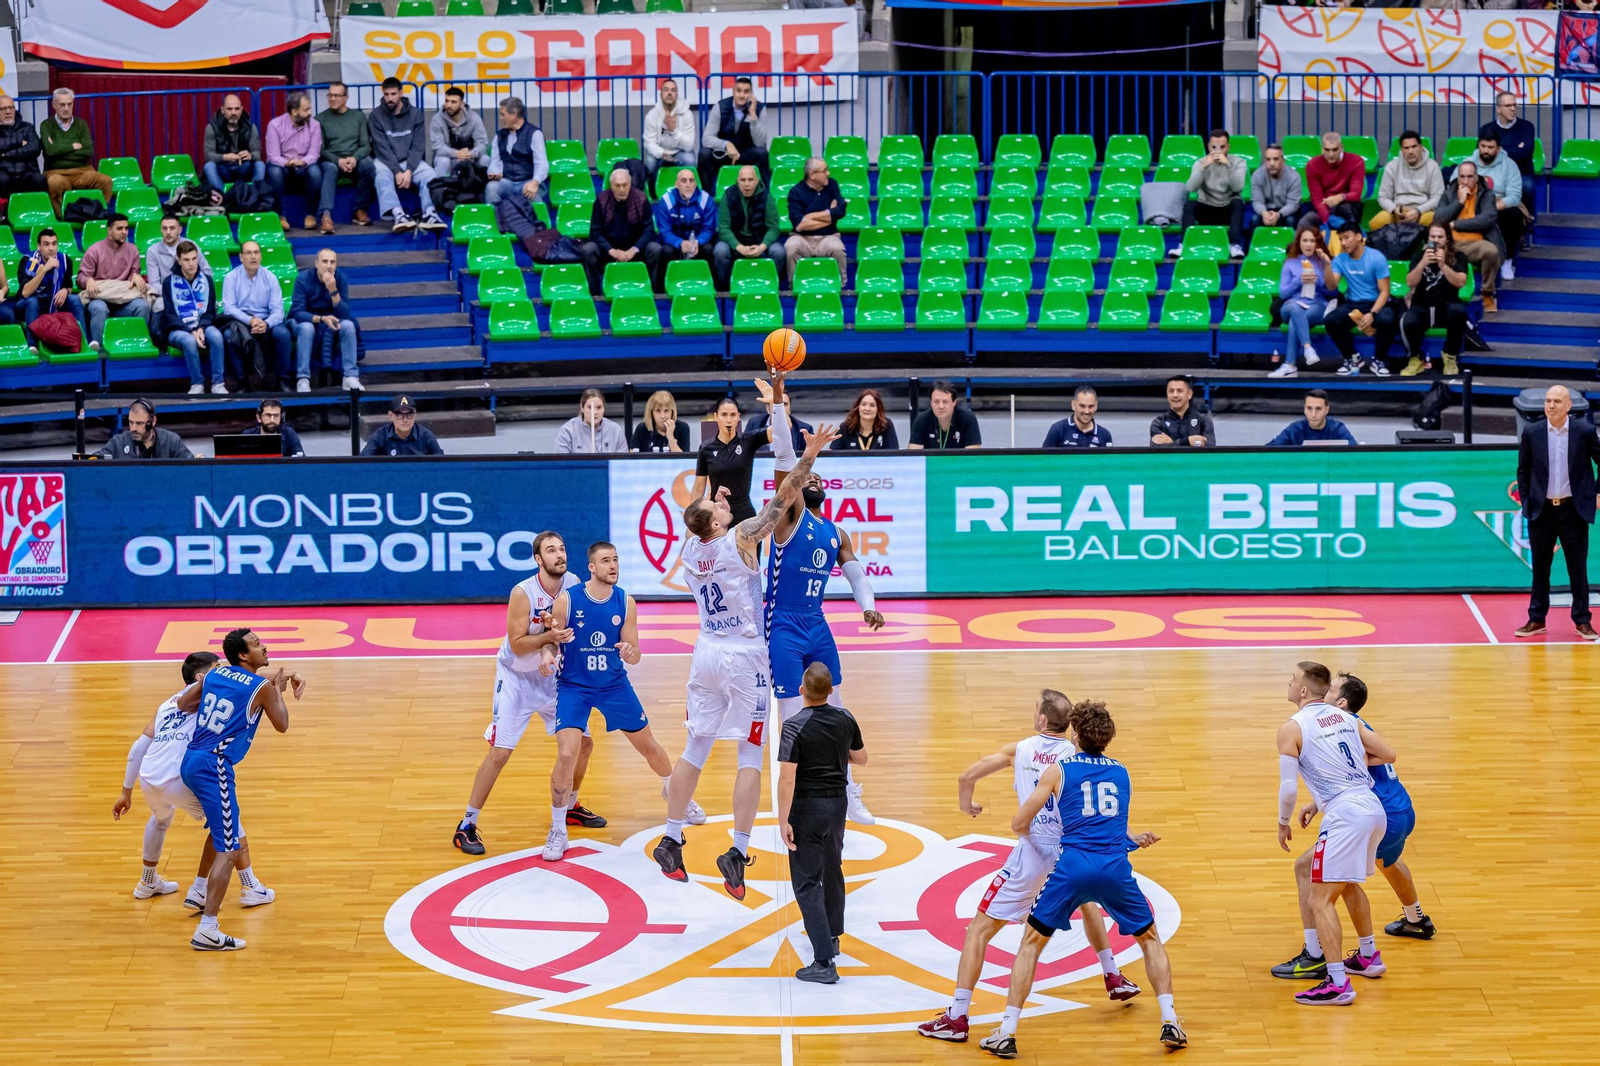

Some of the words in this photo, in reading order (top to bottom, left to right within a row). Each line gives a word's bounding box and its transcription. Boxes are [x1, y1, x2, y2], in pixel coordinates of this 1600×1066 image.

[364, 30, 516, 59] SOLO
[518, 22, 847, 93] GANAR
[369, 62, 511, 94] VALE
[195, 491, 474, 529] MONBUS
[955, 484, 1177, 532] REAL
[1208, 481, 1457, 529] BETIS
[124, 530, 539, 576] OBRADOIRO
[1044, 533, 1367, 560] BALONCESTO
[15, 566, 62, 575] OBRADOIRO
[700, 582, 728, 616] 12
[805, 578, 822, 598] 13
[587, 654, 607, 671] 88
[198, 692, 235, 735] 32
[1317, 713, 1346, 729] DAVISON
[1337, 741, 1357, 770] 3
[1080, 780, 1120, 818] 16
